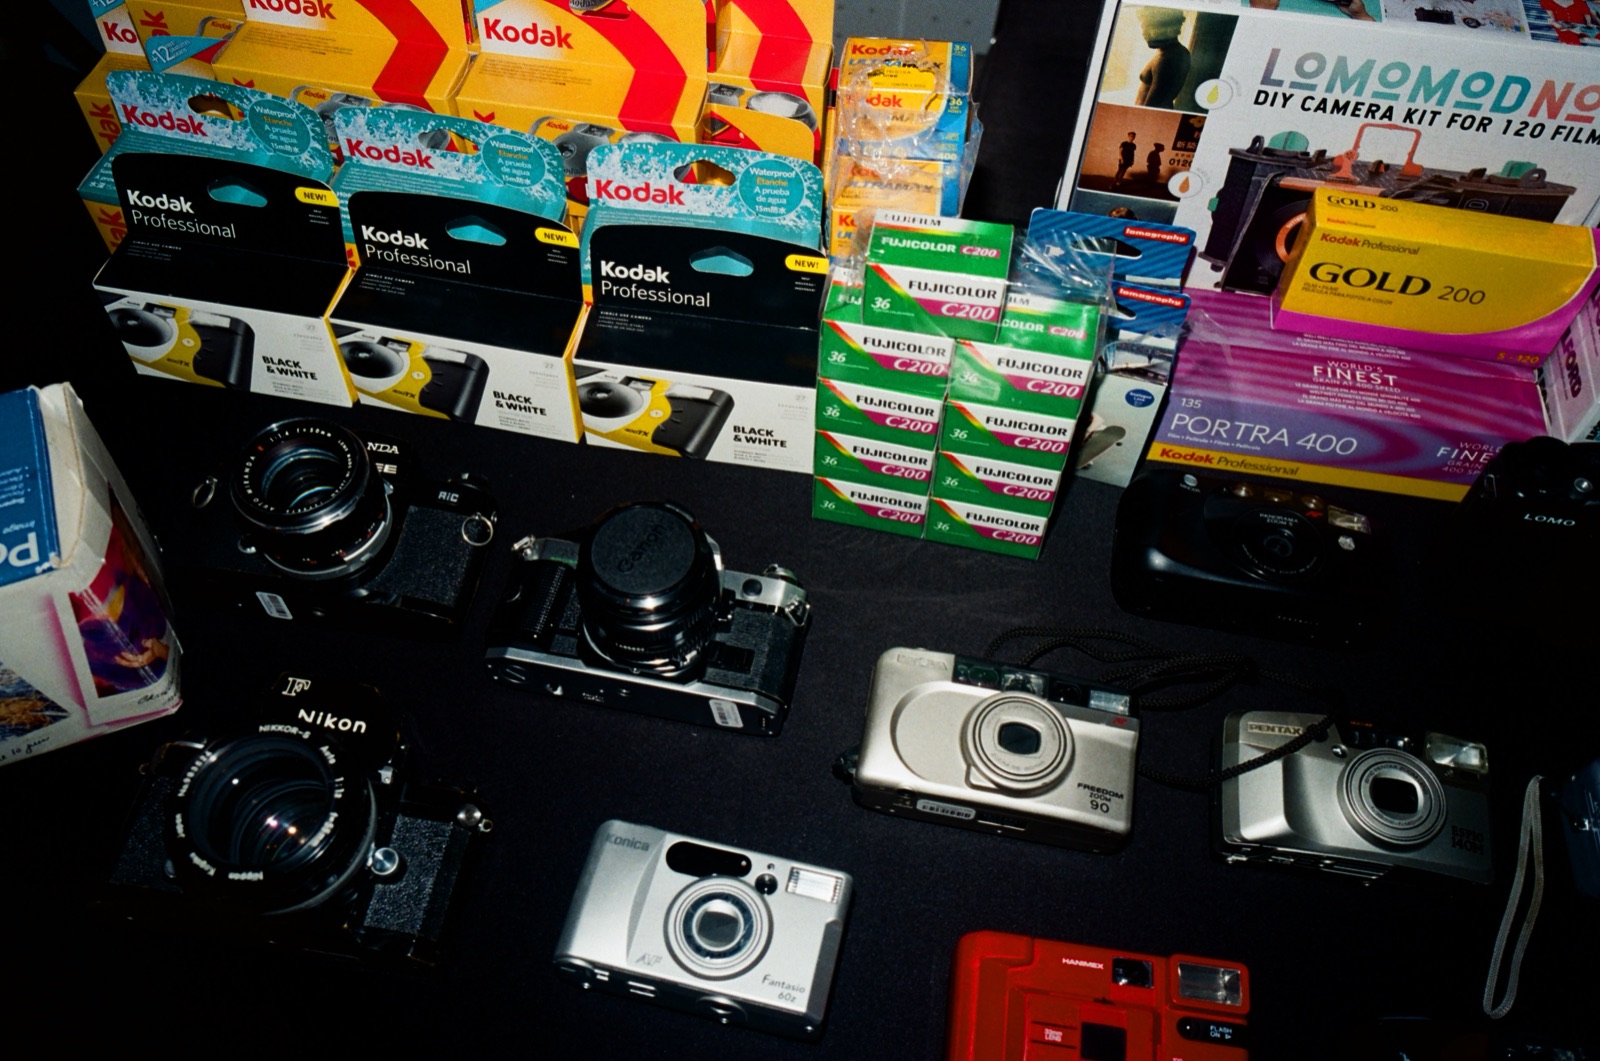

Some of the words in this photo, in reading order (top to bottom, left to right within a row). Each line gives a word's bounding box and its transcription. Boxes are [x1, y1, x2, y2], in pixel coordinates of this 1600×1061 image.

[210, 20, 233, 31] Kodak
[483, 17, 574, 50] Kodak
[953, 44, 967, 52] 36
[304, 89, 328, 101] Kodak
[949, 97, 963, 106] 36
[121, 104, 208, 137] Kodak
[253, 105, 297, 120] Waterproof
[1253, 89, 1295, 108] DIY
[1300, 95, 1395, 122] CAMERA
[1402, 108, 1442, 127] KIT
[1446, 112, 1493, 133] FOR
[1501, 118, 1546, 140] 120
[546, 120, 570, 132] Kodak
[345, 138, 435, 170] Kodak
[489, 139, 534, 154] Waterproof
[749, 167, 797, 179] Waterproof
[302, 190, 328, 203] NEW!
[595, 178, 686, 206] Kodak
[753, 186, 761, 194] A
[761, 187, 790, 197] prueba
[126, 189, 195, 215] Kodak
[755, 195, 767, 203] de
[767, 196, 787, 206] agua
[1327, 195, 1376, 209] GOLD
[1380, 204, 1399, 213] 200
[131, 209, 237, 239] Professional
[361, 225, 430, 250] Kodak
[543, 232, 568, 244] NEW!
[1125, 227, 1187, 243] lomography
[881, 236, 957, 253] FUJICOLOR
[962, 246, 998, 258] C200
[1320, 232, 1361, 247] Kodak
[1361, 239, 1420, 256] Professional
[365, 244, 472, 275] Professional
[794, 259, 819, 269] NEW!
[600, 260, 671, 285] Kodak
[908, 279, 998, 300] FUJICOLOR
[1309, 262, 1432, 296] GOLD
[1437, 286, 1486, 306] 200
[601, 280, 711, 308] Professional
[1119, 287, 1182, 307] lomography
[871, 297, 891, 310] 36
[940, 303, 996, 321] C200
[862, 336, 947, 358] FUJICOLOR
[262, 355, 302, 370] BLACK
[827, 351, 847, 363] 36
[1517, 353, 1540, 364] 120
[266, 364, 276, 374] &
[276, 366, 318, 381] WHITE
[893, 359, 946, 377] C200
[996, 357, 1083, 380] FUJICOLOR
[1327, 360, 1383, 373] WORLD'S
[958, 371, 979, 384] 36
[1313, 365, 1398, 386] FINEST
[1026, 380, 1080, 398] C200
[1313, 377, 1340, 385] GRAIN
[1375, 384, 1401, 393] SPEED
[493, 390, 533, 405] BLACK
[855, 394, 936, 417] FUJICOLOR
[1181, 397, 1203, 409] 135
[495, 400, 504, 409] &
[505, 401, 547, 416] WHITE
[823, 405, 841, 418] 36
[733, 424, 774, 437] BLACK
[885, 416, 934, 434] C200
[985, 416, 1068, 438] FUJICOLOR
[733, 434, 742, 442] &
[744, 435, 787, 448] WHITE
[950, 428, 968, 440] 36
[1170, 412, 1290, 447] PORTRA
[1296, 432, 1358, 456] 400
[1014, 437, 1066, 454] C200
[821, 455, 838, 466] 36
[852, 445, 929, 467] FUJICOLOR
[1159, 447, 1214, 465] Kodak
[1216, 456, 1299, 476] Professional
[1436, 446, 1494, 464] FINE
[880, 465, 928, 481] C200
[1441, 466, 1464, 474] 400
[1447, 461, 1483, 470] GRAIN
[941, 476, 959, 487] 36
[975, 466, 1054, 487] FUJICOLOR
[850, 490, 923, 511] FUJICOLOR
[1002, 485, 1051, 501] C200
[820, 500, 836, 511] 36
[877, 509, 922, 525] C200
[966, 511, 1040, 532] FUJICOLOR
[1259, 511, 1300, 525] PANORAMA
[1523, 512, 1576, 528] LOMO
[933, 521, 950, 532] 36
[992, 530, 1038, 545] C200
[616, 522, 669, 574] Canon
[281, 676, 312, 697] F
[297, 708, 368, 734] Nikon
[1249, 723, 1302, 735] PENTAX
[258, 723, 312, 740] NIKKOR-S
[1077, 782, 1125, 799] FREEDOM
[1088, 791, 1112, 803] ZOOM
[1089, 798, 1110, 814] 90
[604, 832, 650, 851] Konica
[1451, 825, 1485, 844] ESPIO
[1061, 957, 1105, 970] HANIMEX
[761, 973, 807, 995] Fantasio
[777, 991, 797, 1003] 60z
[1209, 1024, 1234, 1035] FLASH
[1209, 1031, 1221, 1039] ON
